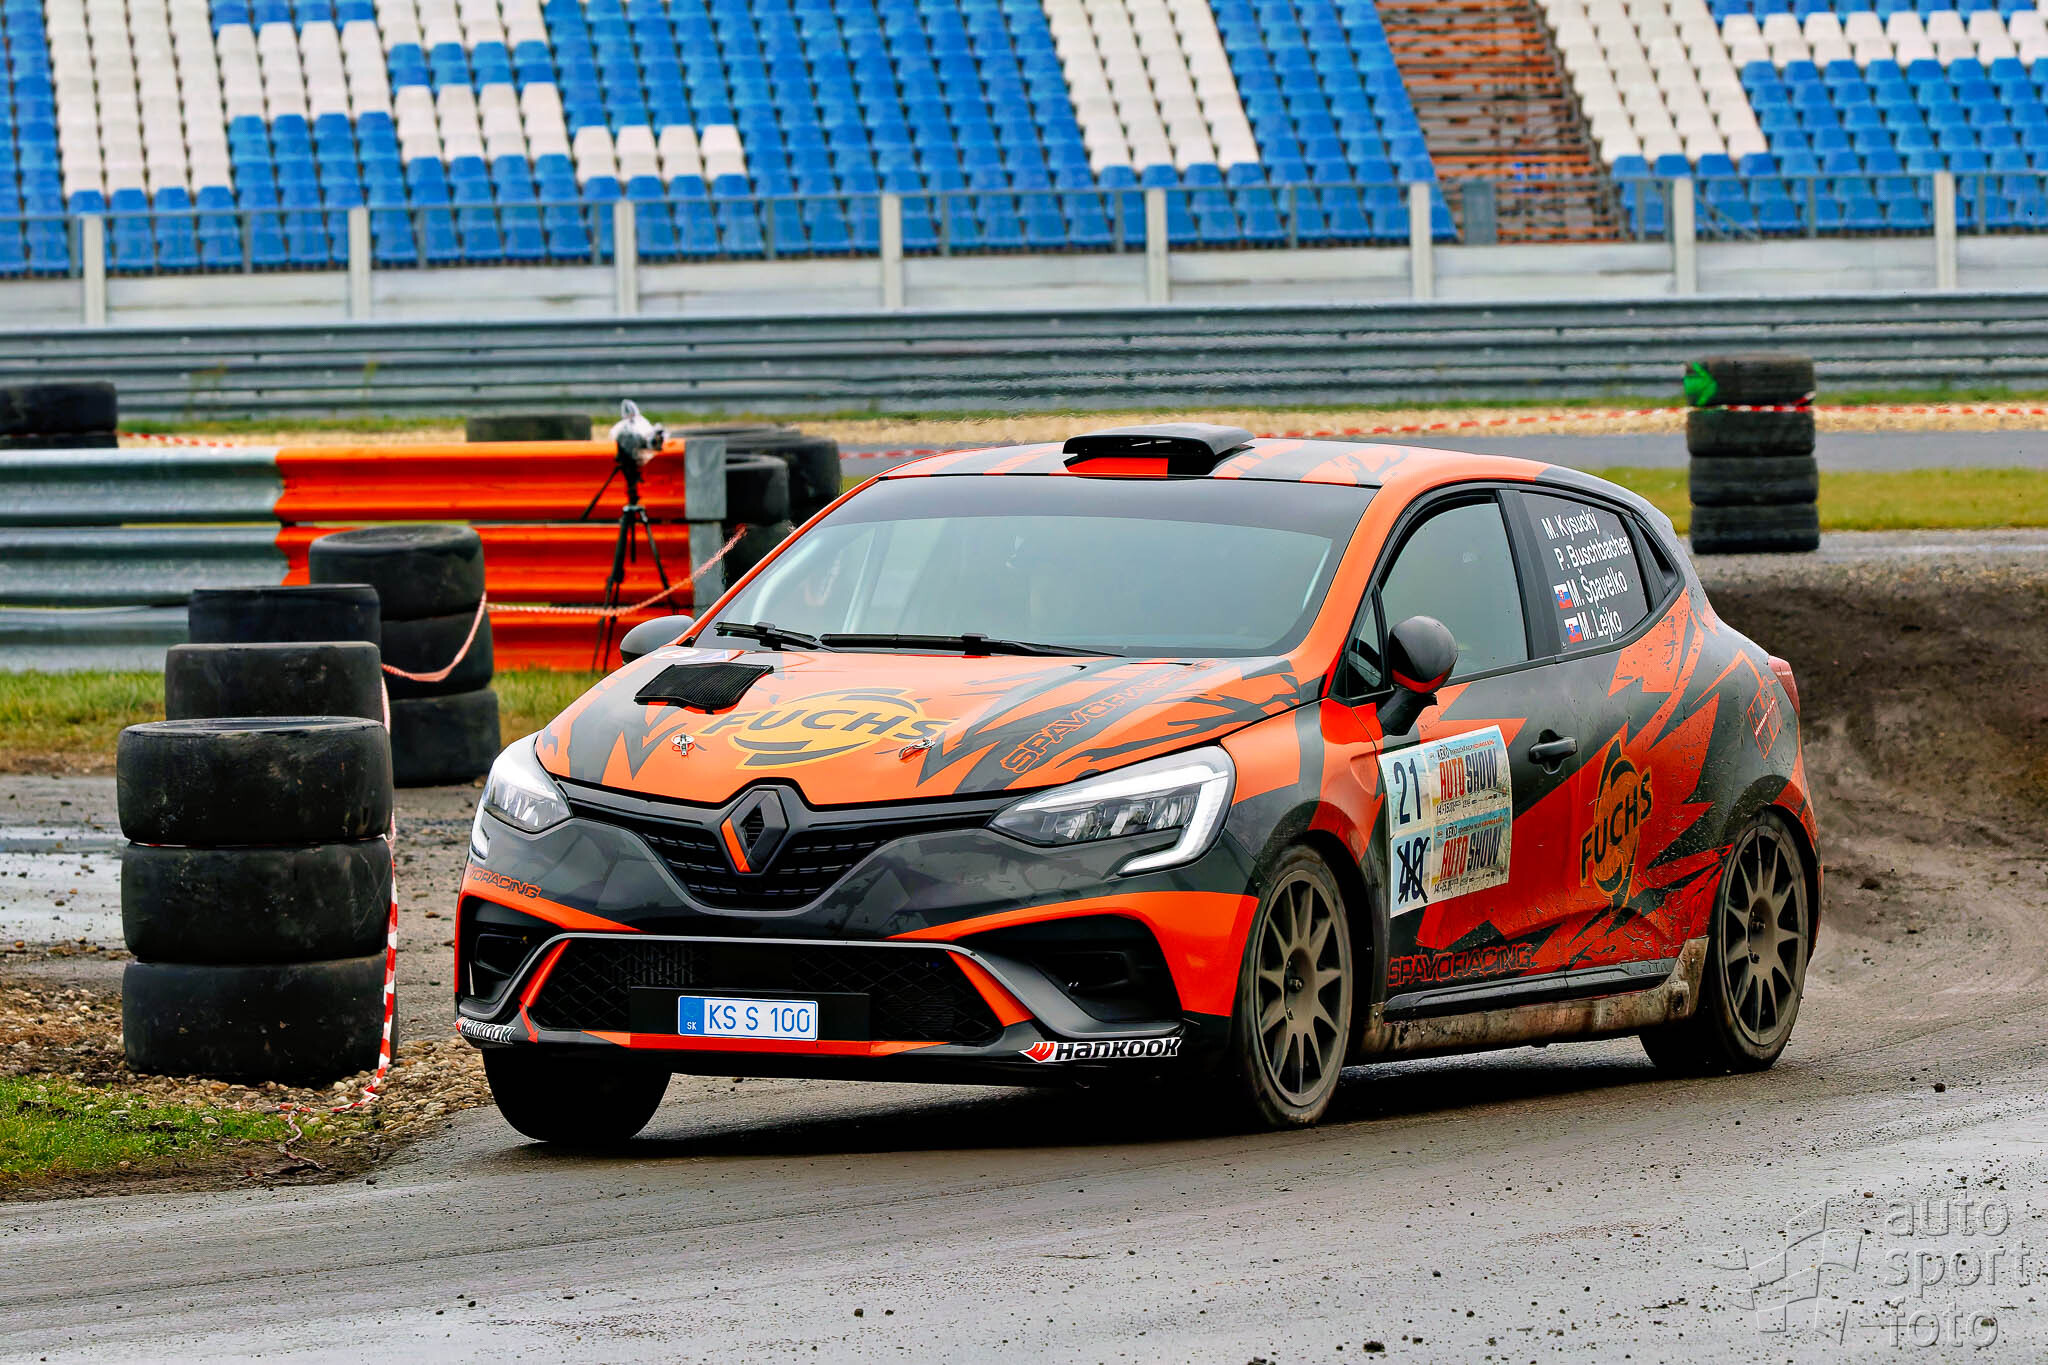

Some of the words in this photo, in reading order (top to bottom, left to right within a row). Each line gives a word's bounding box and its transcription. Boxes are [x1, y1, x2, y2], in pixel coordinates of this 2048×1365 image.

[1541, 517, 1559, 540] M.
[1555, 507, 1600, 541] Kysucký
[1554, 546, 1570, 571] P.
[1566, 534, 1632, 569] Buschbacher
[1566, 579, 1585, 608] M.
[1577, 612, 1595, 641] M.
[1591, 606, 1622, 642] Lejko
[700, 709, 952, 740] FUCHS
[1393, 758, 1421, 825] 21
[1440, 757, 1465, 801] AUTO
[1465, 748, 1497, 793] SHOW
[1581, 771, 1653, 881] FUCHS
[1440, 835, 1469, 880] AUTO
[1467, 825, 1501, 871] SHOW
[686, 1021, 697, 1031] SK
[709, 1004, 737, 1030] KS
[745, 1006, 759, 1031] S
[770, 1007, 810, 1033] 100
